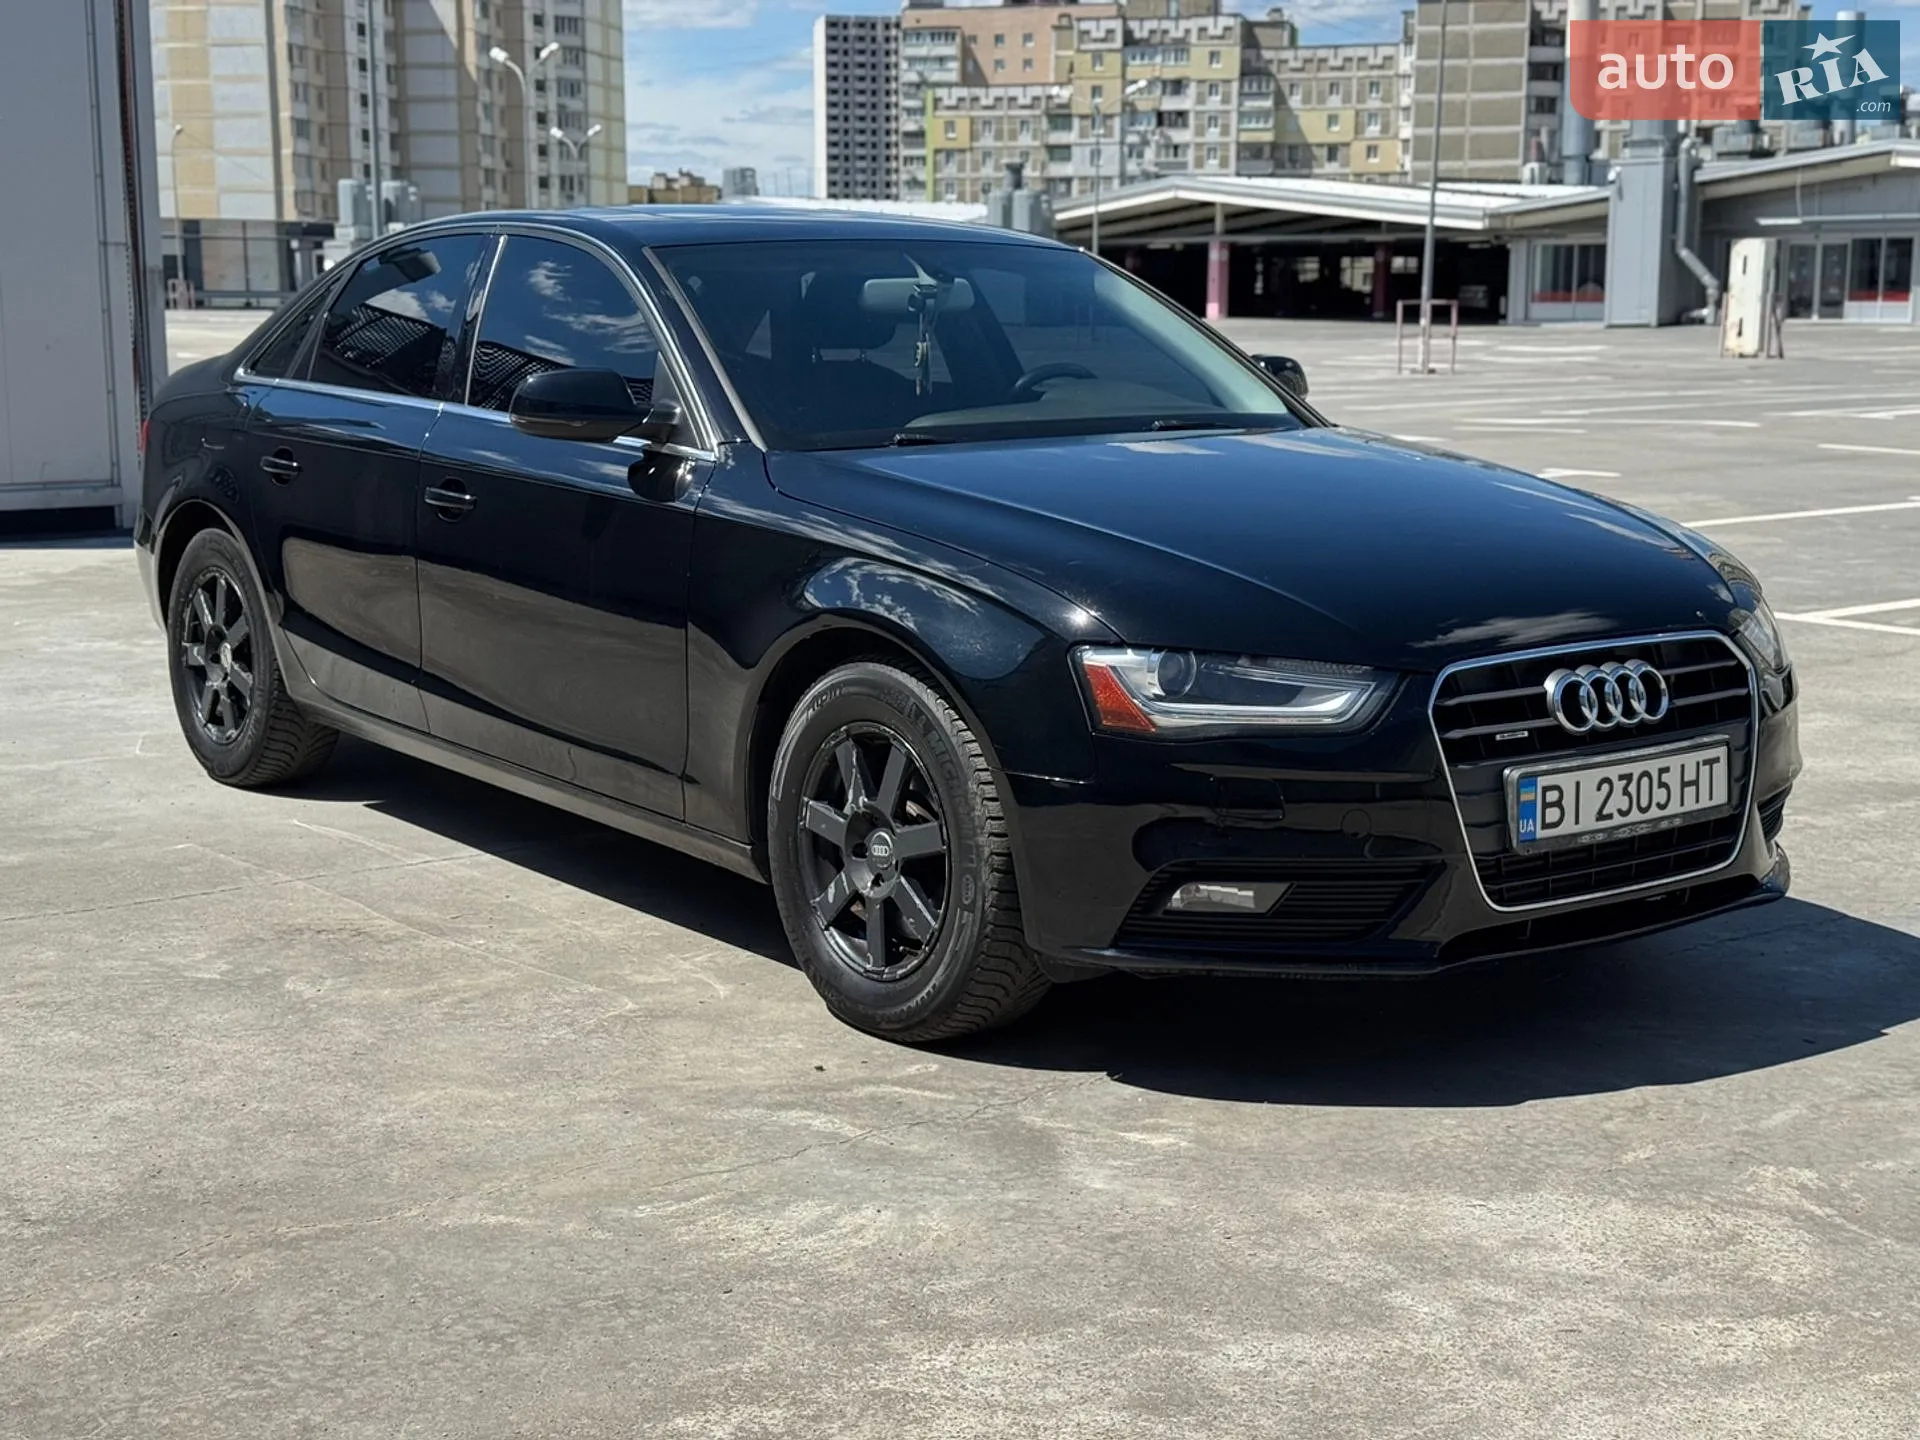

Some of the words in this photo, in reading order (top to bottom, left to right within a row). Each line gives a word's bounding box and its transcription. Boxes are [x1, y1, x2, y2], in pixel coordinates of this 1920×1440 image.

[1541, 781, 1581, 831] BI
[1596, 766, 1672, 822] 2305
[1680, 756, 1720, 807] HT
[1520, 818, 1535, 833] UA
